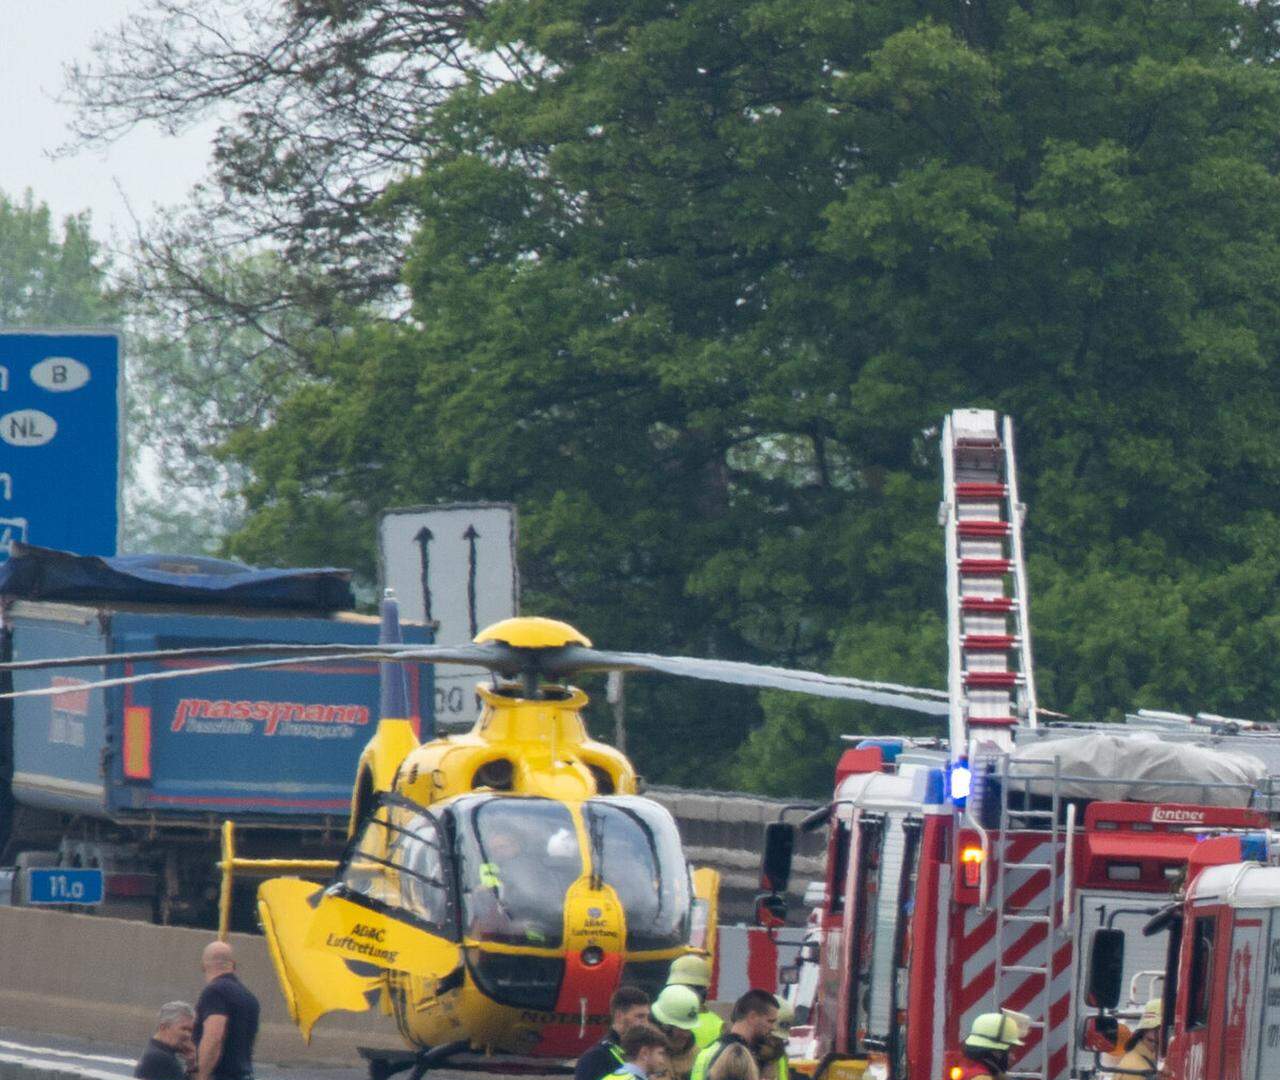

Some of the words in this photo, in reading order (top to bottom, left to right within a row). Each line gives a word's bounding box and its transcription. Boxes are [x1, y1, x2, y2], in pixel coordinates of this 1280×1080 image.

[51, 364, 68, 384] B
[9, 416, 42, 439] NL
[351, 923, 386, 943] ADAC
